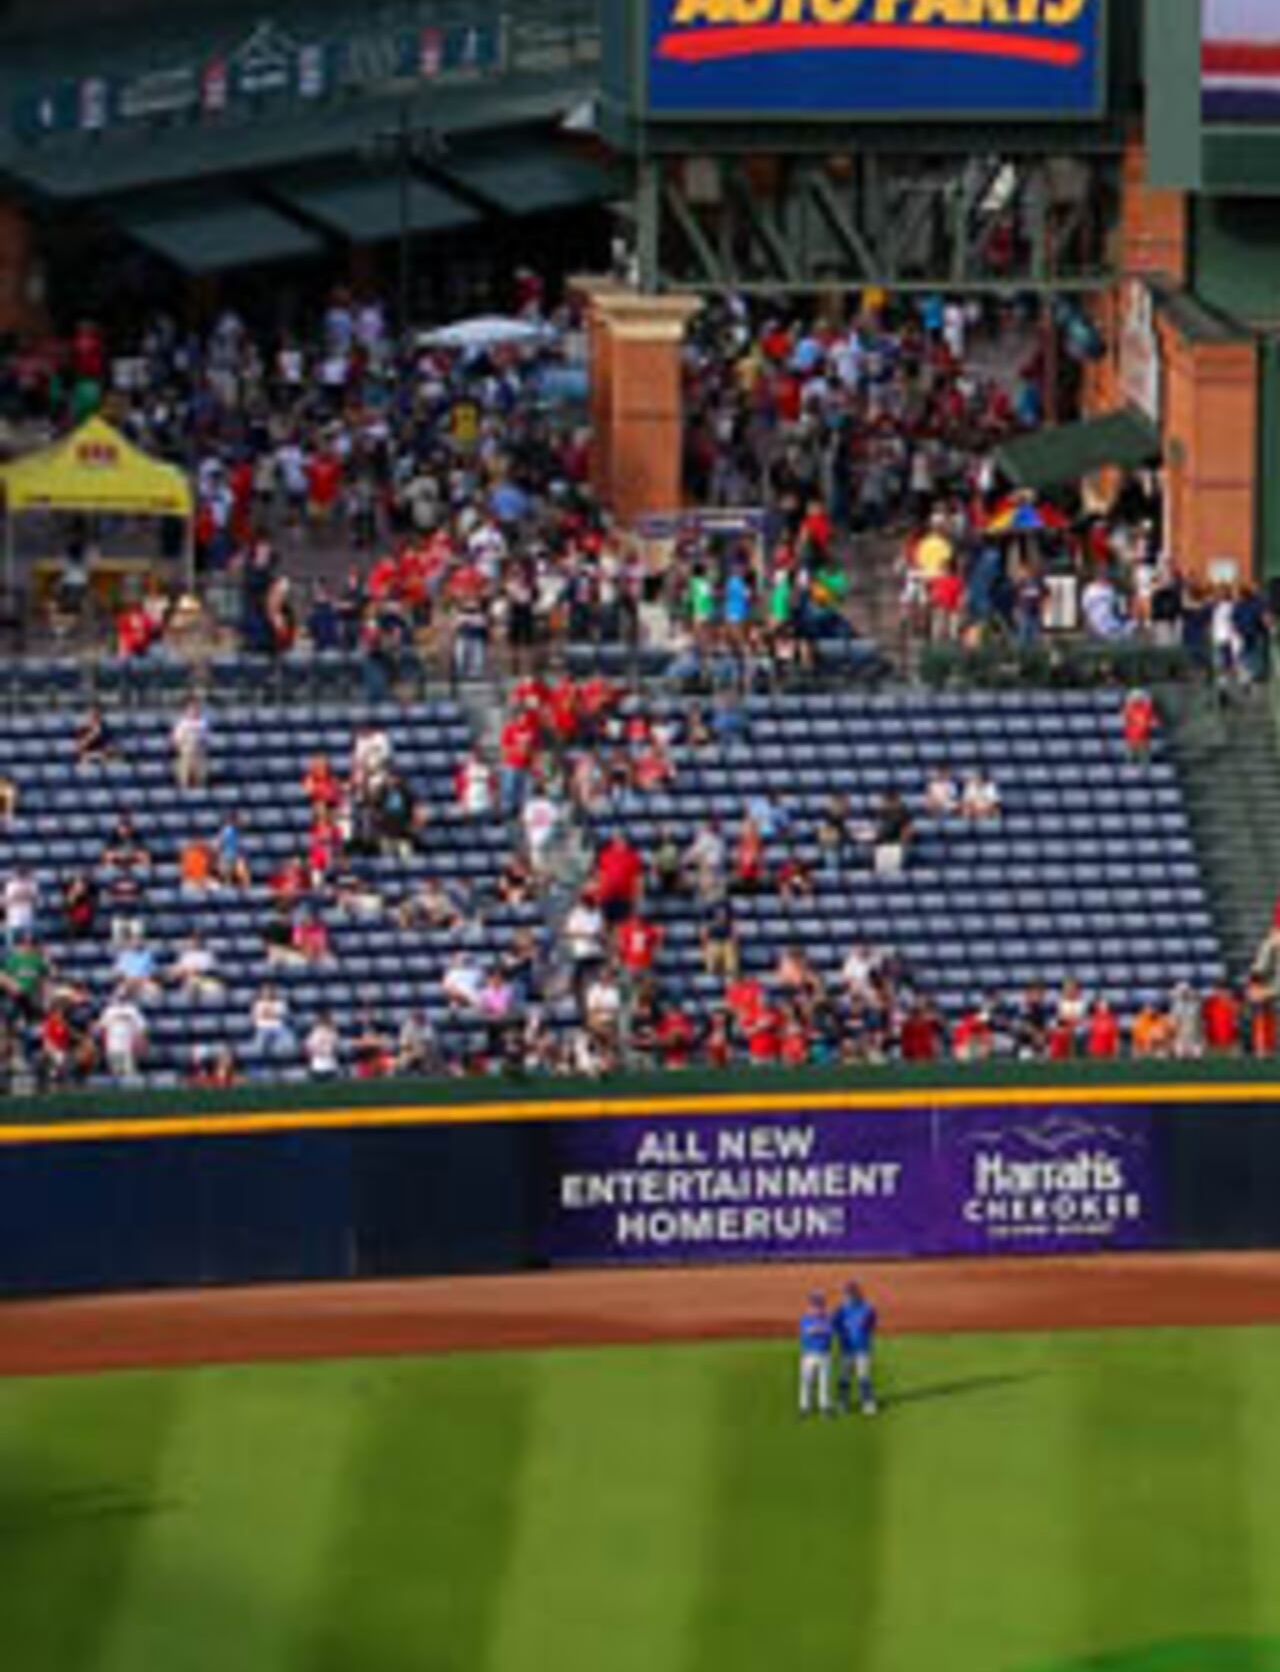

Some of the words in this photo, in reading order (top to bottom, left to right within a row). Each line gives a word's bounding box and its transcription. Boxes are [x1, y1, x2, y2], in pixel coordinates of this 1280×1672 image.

[636, 1130, 708, 1166] ALL
[717, 1125, 816, 1162] NEW
[560, 1162, 903, 1209] ENTERTAINMENT
[962, 1192, 1141, 1222] CHEROKEE
